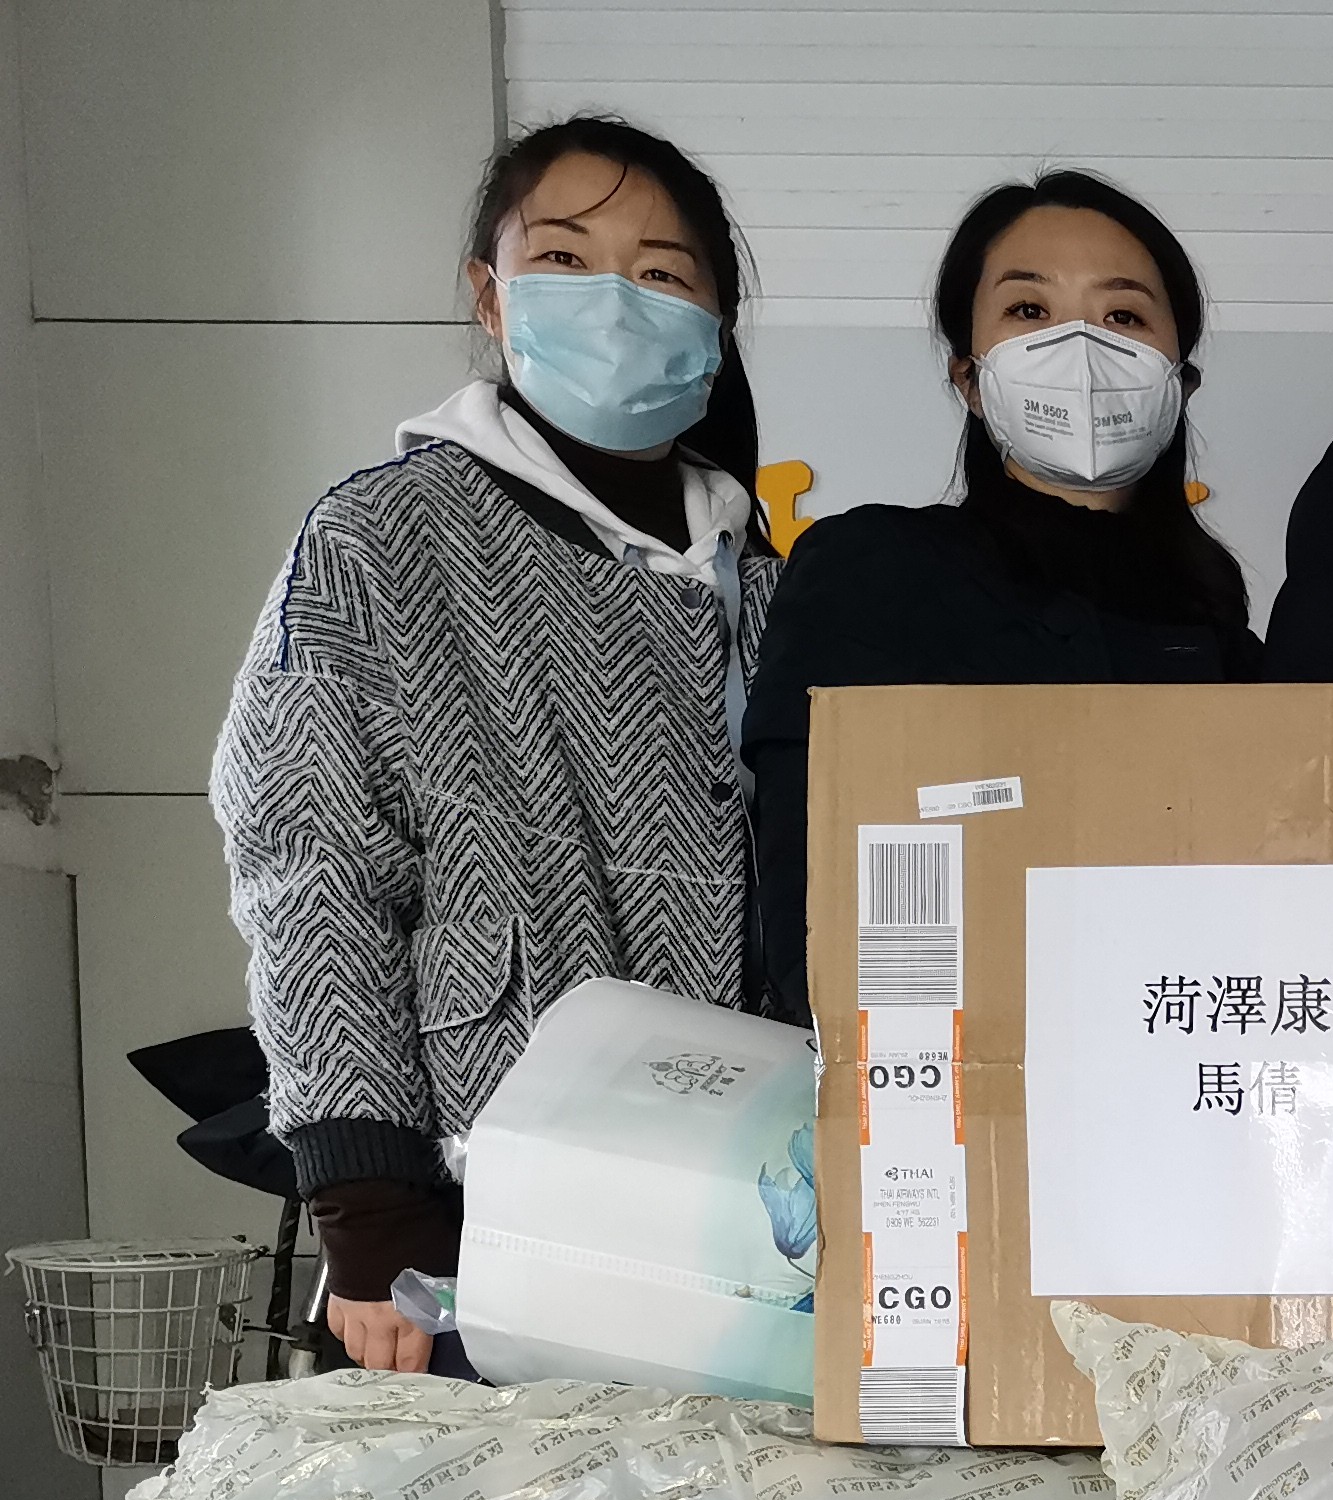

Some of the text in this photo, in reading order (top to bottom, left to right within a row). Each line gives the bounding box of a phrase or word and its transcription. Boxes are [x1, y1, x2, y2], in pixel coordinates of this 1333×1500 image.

[1024, 399, 1069, 421] 3M 9502
[869, 1065, 941, 1088] CGO
[901, 1168, 933, 1180] THAI
[878, 1286, 952, 1310] CGO
